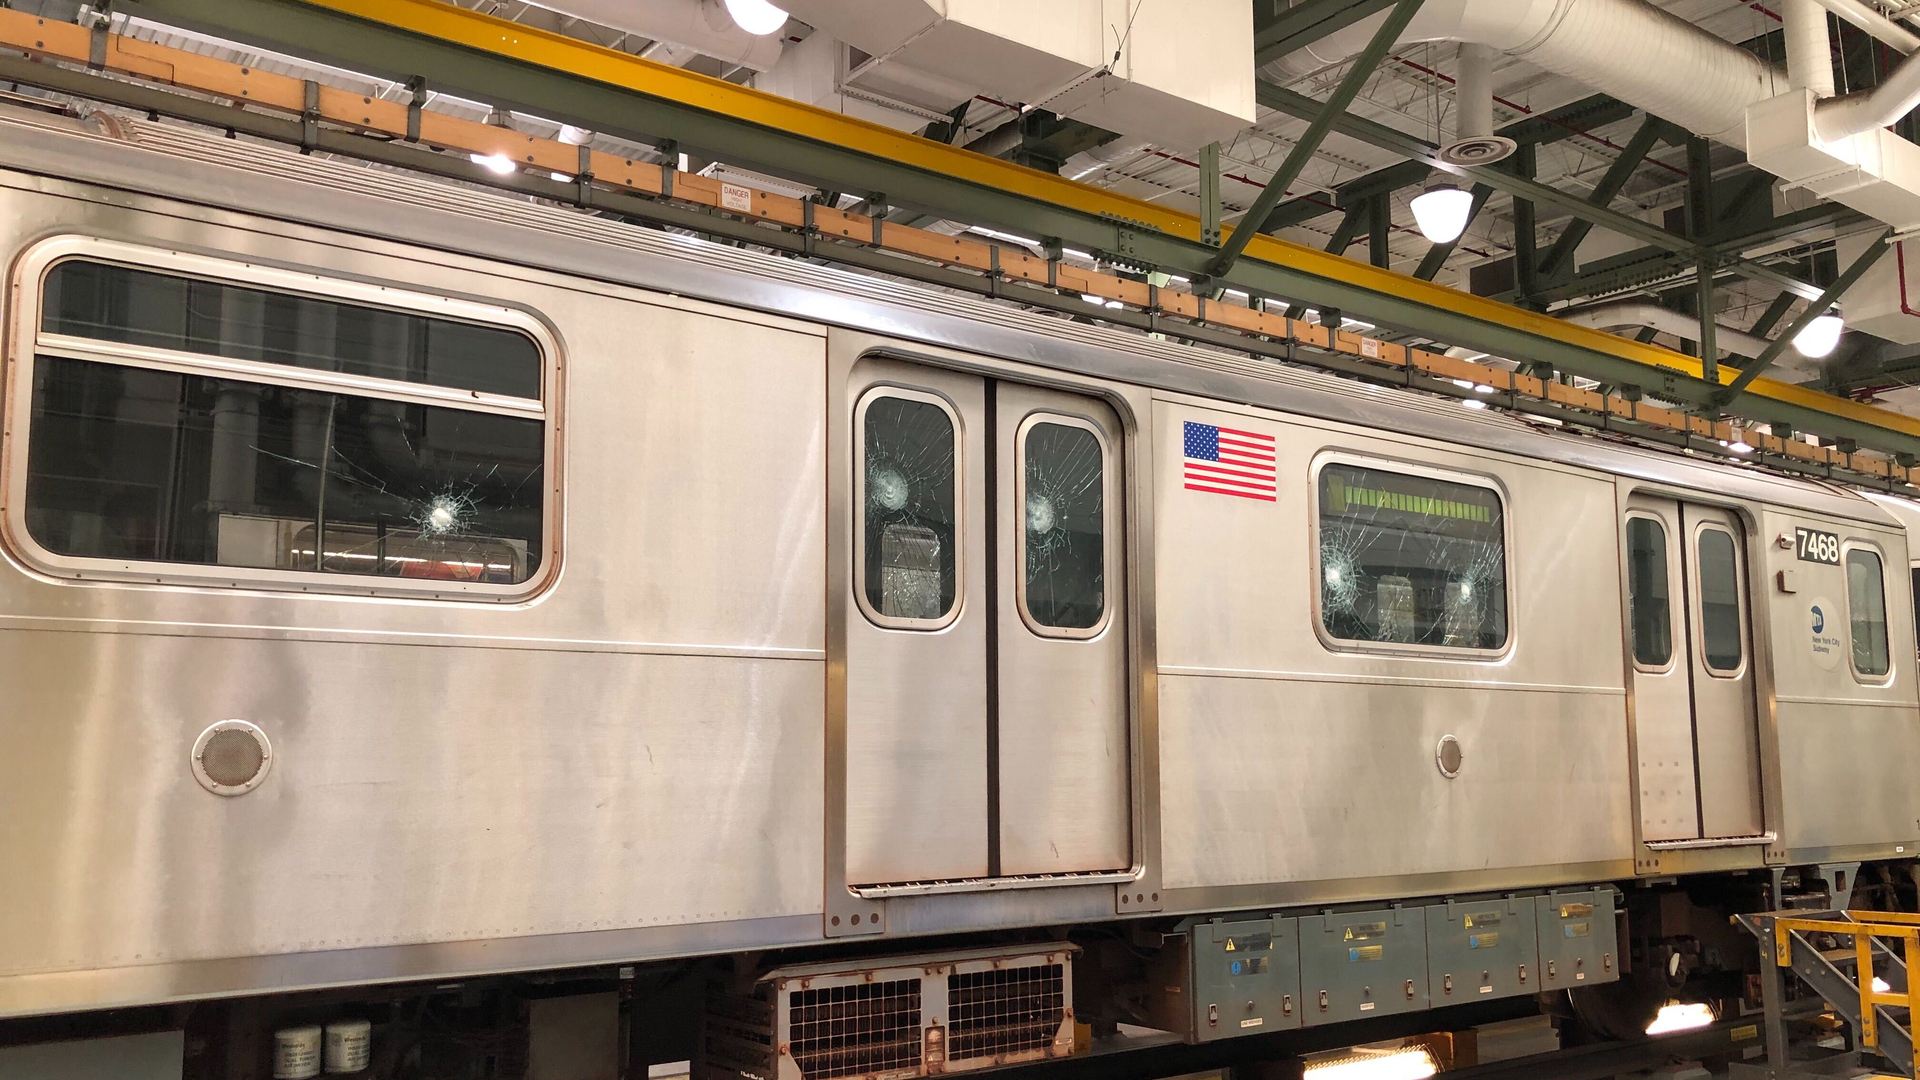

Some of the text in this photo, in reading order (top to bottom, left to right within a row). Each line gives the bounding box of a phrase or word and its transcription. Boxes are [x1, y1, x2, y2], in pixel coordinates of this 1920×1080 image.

[724, 186, 749, 199] DANGER
[1796, 529, 1839, 563] 7468
[1812, 636, 1840, 647] New York City
[1813, 644, 1830, 654] Subway
